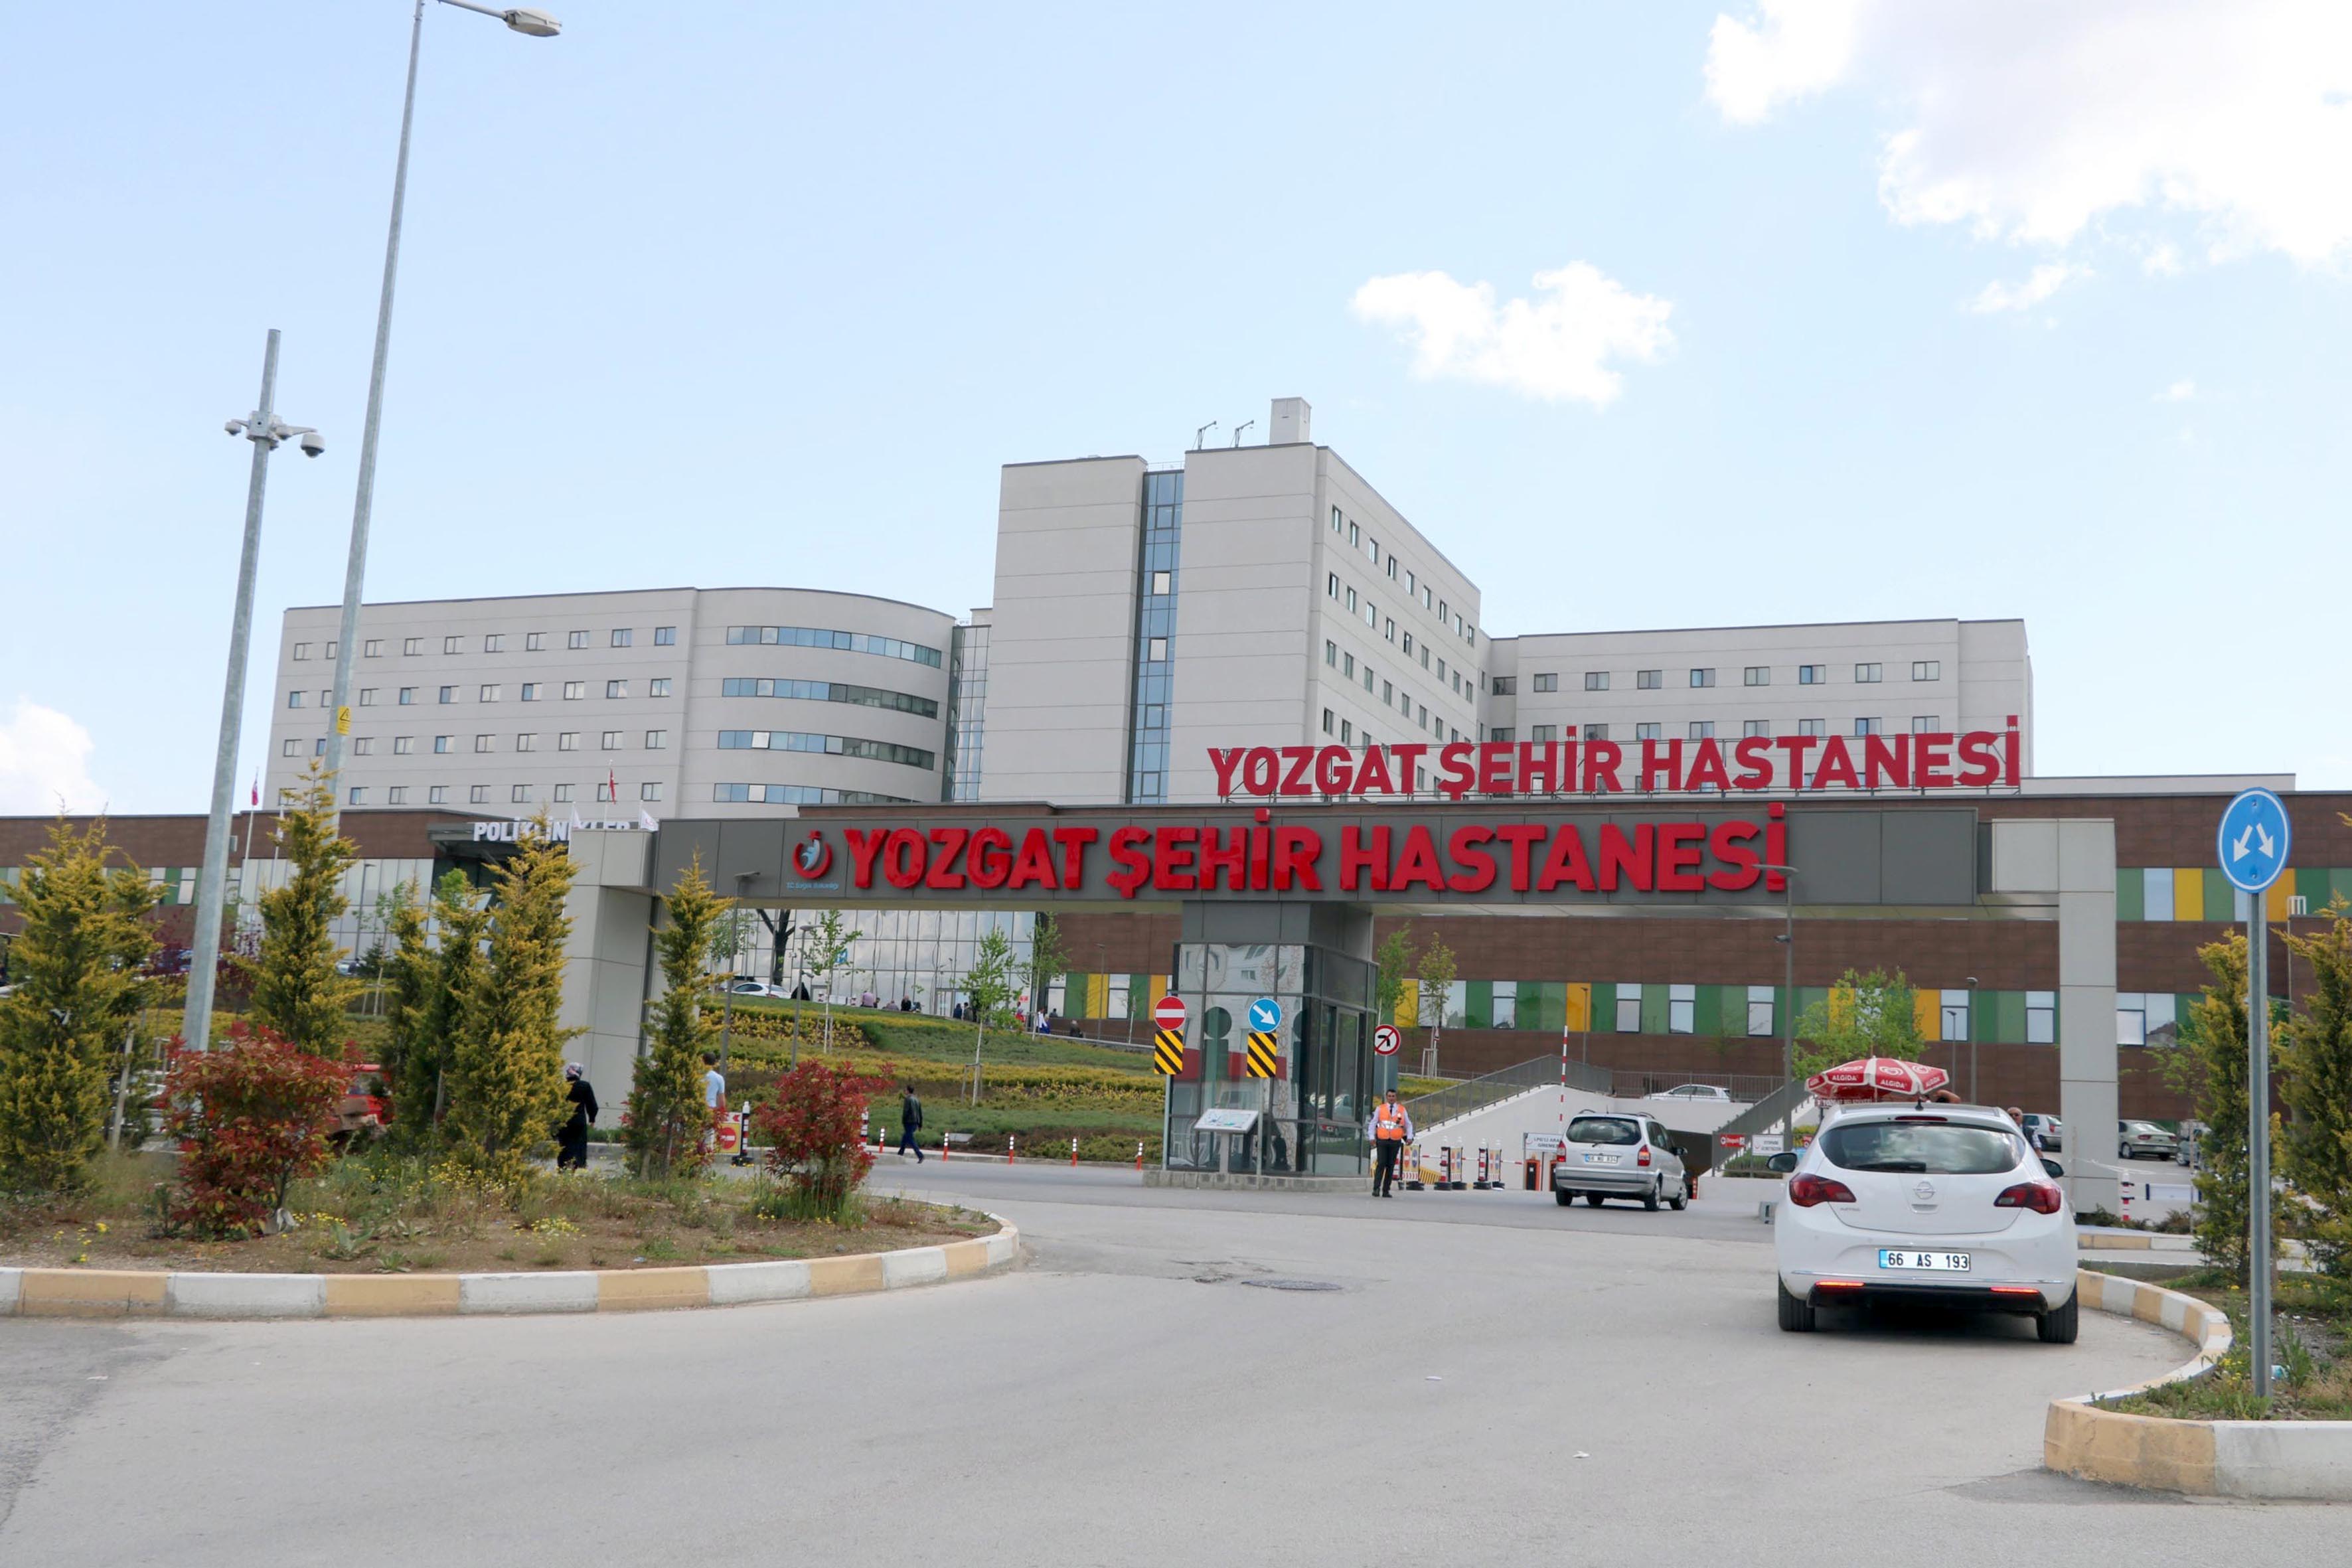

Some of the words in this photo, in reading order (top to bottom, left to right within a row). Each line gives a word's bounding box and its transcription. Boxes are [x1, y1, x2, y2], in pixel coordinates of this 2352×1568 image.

[1208, 743, 1428, 797] YOZGAT
[1438, 726, 1623, 801] ŞEHİR
[1642, 715, 2020, 791] HASTANESİ
[843, 826, 1099, 890] YOZGAT
[1104, 807, 1323, 899] ŞEHİR
[1339, 802, 1787, 892] HASTANESİ
[1888, 1253, 1904, 1266] 66
[1917, 1253, 1932, 1267] AS
[1946, 1255, 1968, 1269] 193
